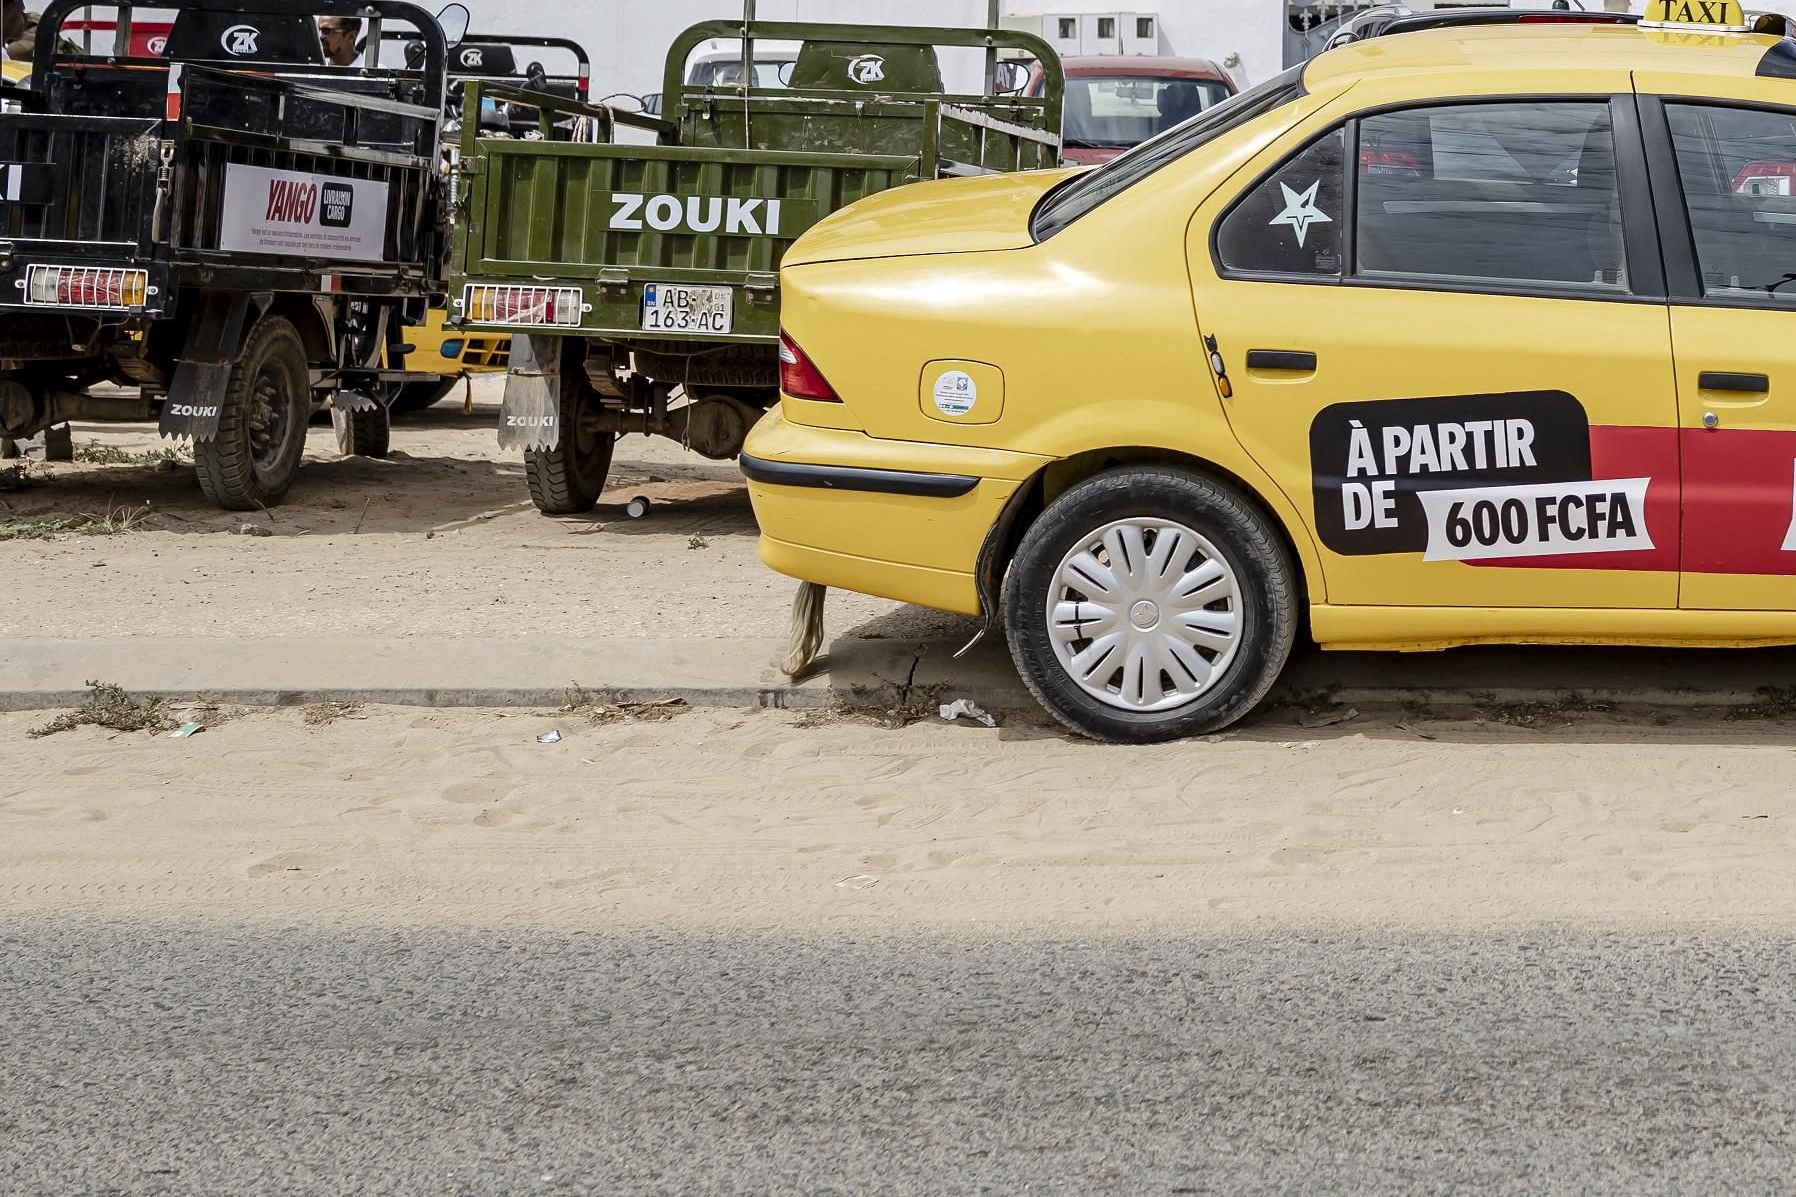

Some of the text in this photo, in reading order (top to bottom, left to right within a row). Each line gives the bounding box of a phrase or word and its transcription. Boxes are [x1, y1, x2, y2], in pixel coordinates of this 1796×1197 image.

[1658, 0, 1729, 24] TAXI
[266, 179, 318, 224] YANGO
[323, 189, 350, 207] LIVRAISON
[327, 206, 345, 220] CARGO
[609, 193, 781, 235] ZOUKI
[170, 403, 218, 417] ZOUKI
[506, 415, 554, 427] ZOUKI
[1347, 418, 1537, 477] À PARTIR
[1342, 480, 1398, 530] DE
[1446, 492, 1638, 548] 600 FCFA
